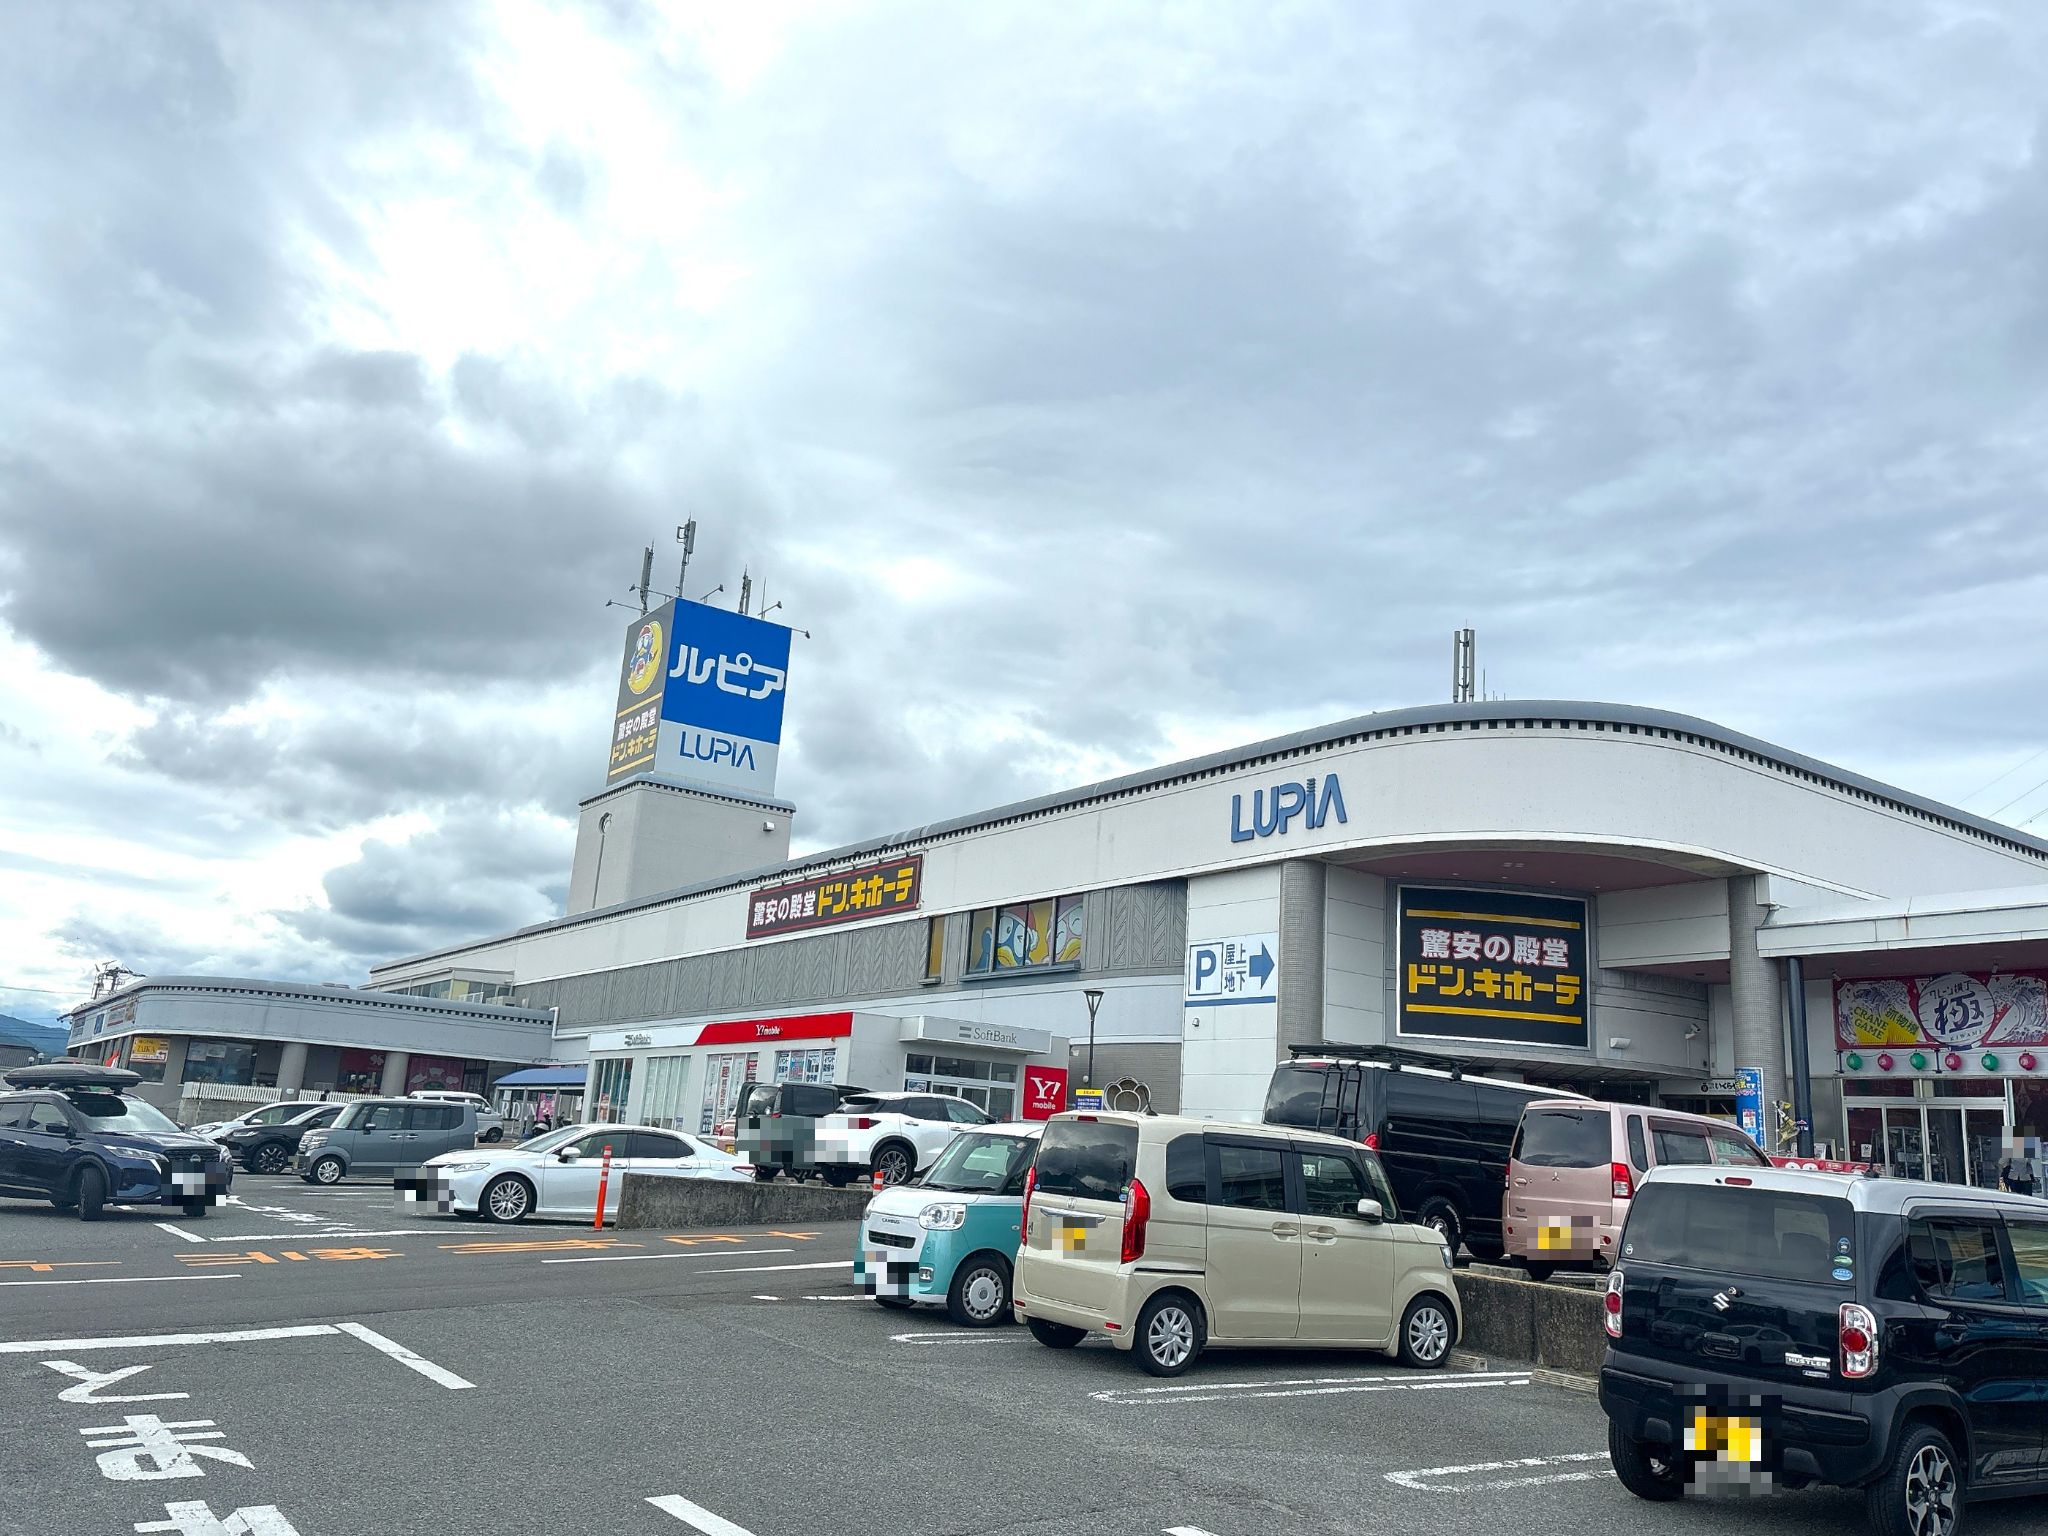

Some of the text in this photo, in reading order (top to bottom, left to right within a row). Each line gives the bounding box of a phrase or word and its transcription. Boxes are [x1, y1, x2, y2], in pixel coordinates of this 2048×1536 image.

[669, 644, 785, 700] ルピア
[617, 706, 657, 742] 驚安の殿堂
[679, 731, 756, 772] LUPIA
[1230, 773, 1348, 843] LUPIA
[752, 890, 817, 927] 驚安の殿堂
[1224, 943, 1247, 967] 屋上
[1420, 928, 1570, 968] 驚安の殿堂
[1195, 949, 1217, 991] P
[1224, 970, 1247, 993] 地下
[1853, 1006, 1889, 1031] CRANE
[1934, 991, 1985, 1036] 極
[974, 1027, 1018, 1045] SoftBank
[1854, 1018, 1885, 1040] GAME
[1030, 1076, 1062, 1100] Y!
[1032, 1100, 1056, 1111] mobile
[1788, 1356, 1828, 1368] HUSTLER
